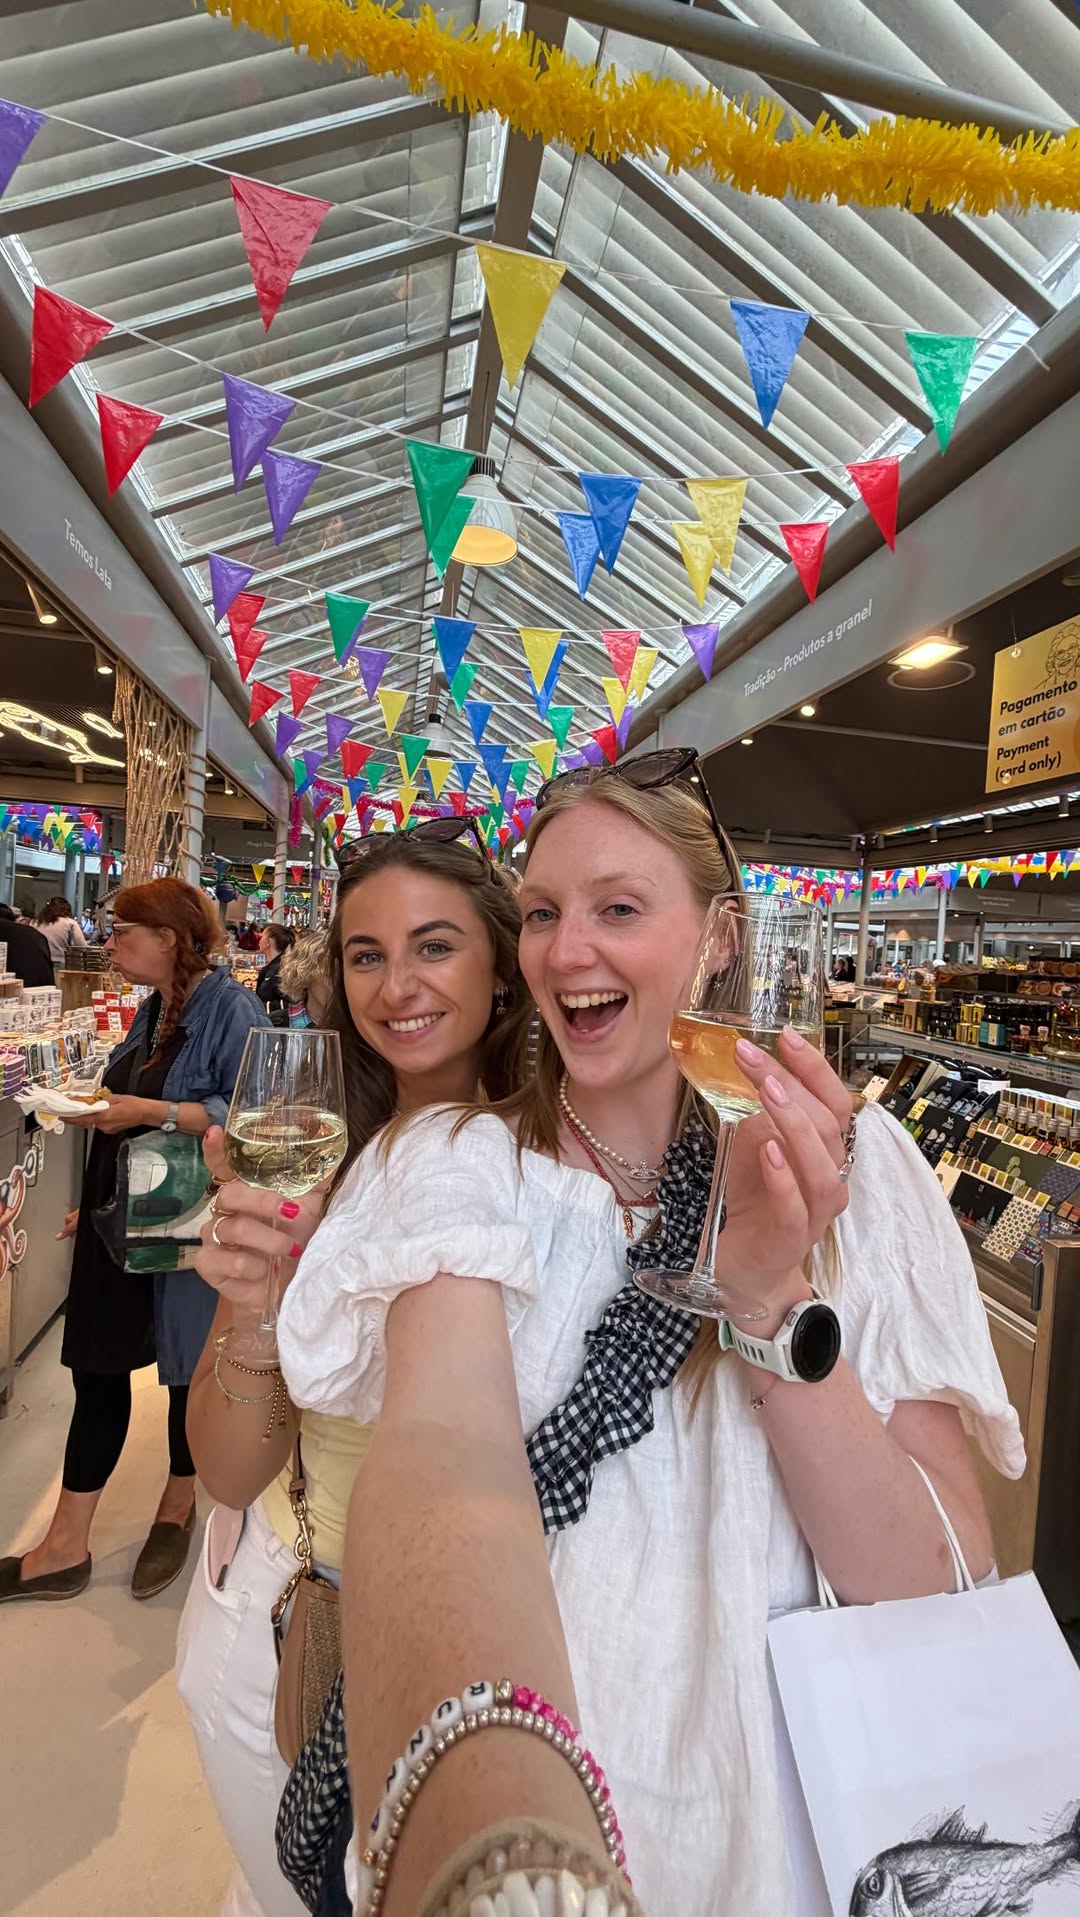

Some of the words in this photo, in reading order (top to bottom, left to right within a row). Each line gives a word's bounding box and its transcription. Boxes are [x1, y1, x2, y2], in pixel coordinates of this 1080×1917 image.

[64, 518, 94, 569] Temos
[95, 556, 112, 591] Lata
[744, 668, 776, 697] Tradição
[783, 635, 826, 672] Produtos
[827, 630, 834, 643] a
[835, 598, 873, 640] granel
[1000, 680, 1078, 716] Pagamento
[998, 722, 1018, 737] em
[1020, 706, 1067, 729] cartão
[996, 735, 1050, 761] Payment
[995, 759, 1026, 782] (card
[1029, 751, 1062, 773] only)
